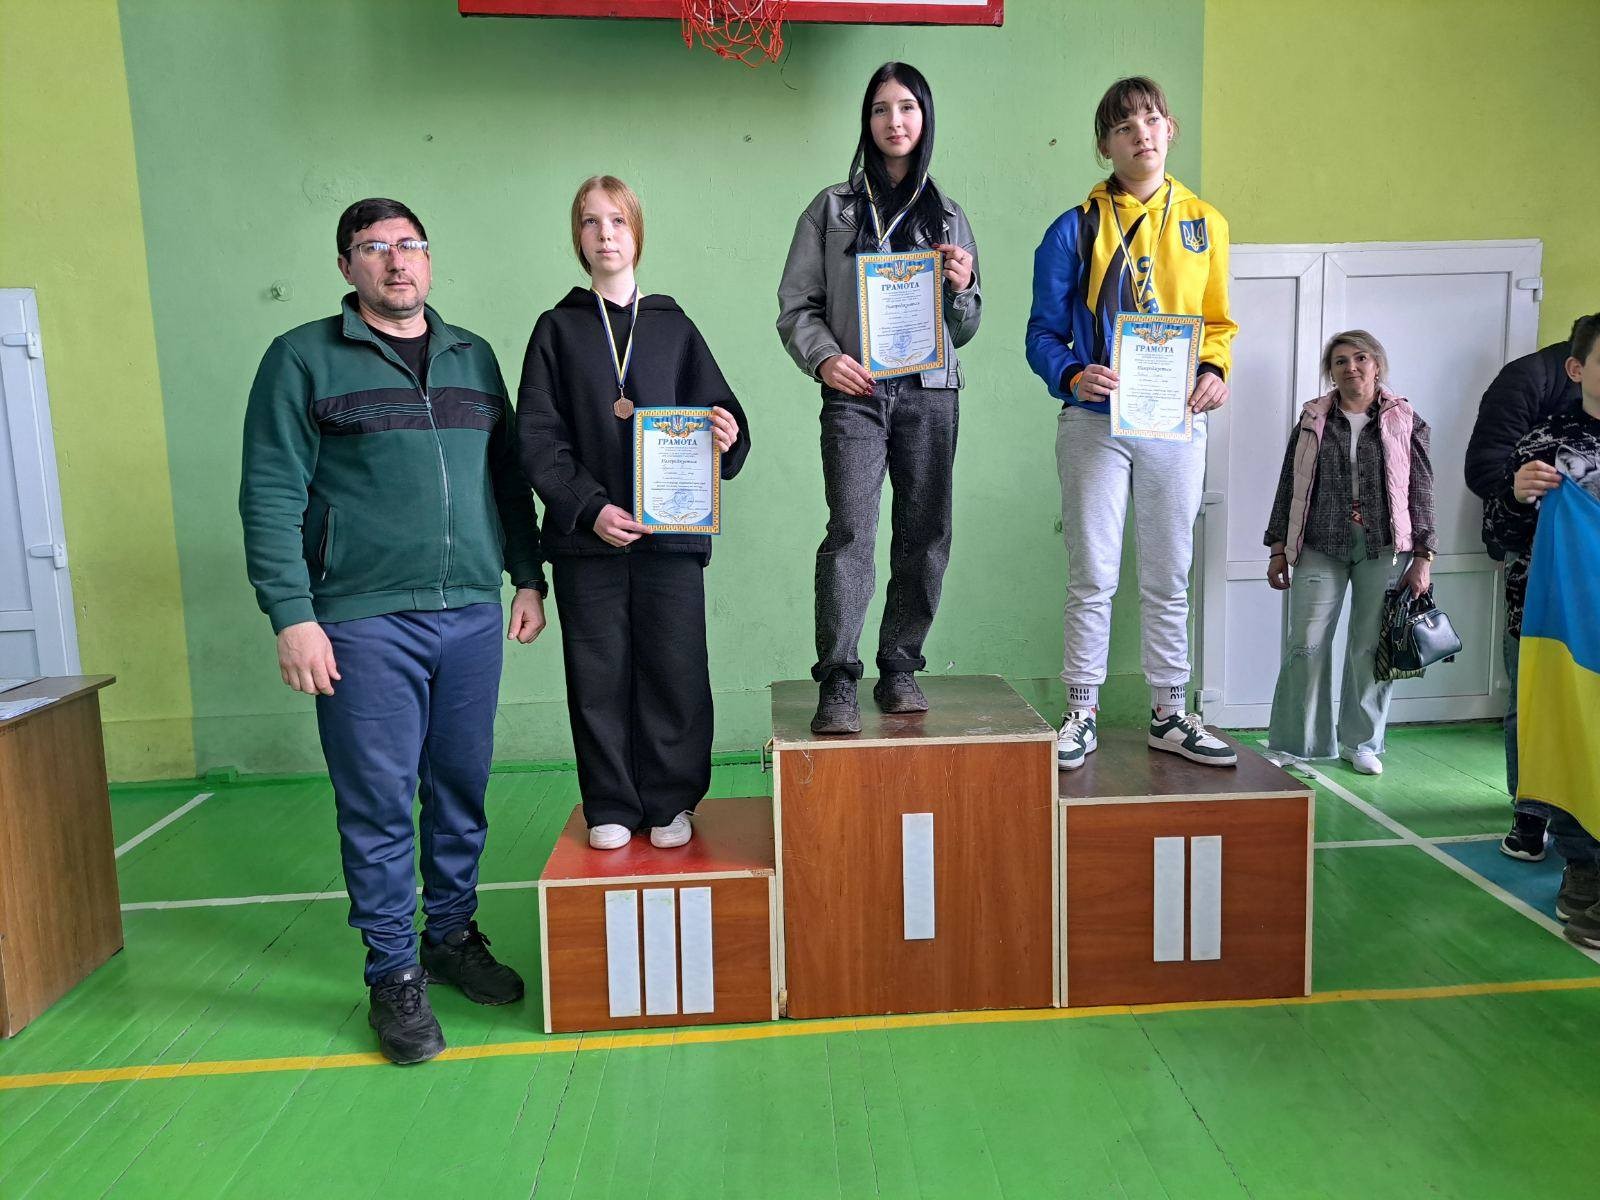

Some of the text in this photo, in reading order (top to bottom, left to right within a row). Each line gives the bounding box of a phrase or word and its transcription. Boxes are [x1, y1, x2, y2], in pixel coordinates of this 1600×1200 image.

[881, 282, 920, 291] ГРАМОТА
[1135, 344, 1174, 353] ГРАМОТА
[658, 438, 698, 446] ГРАМОТА
